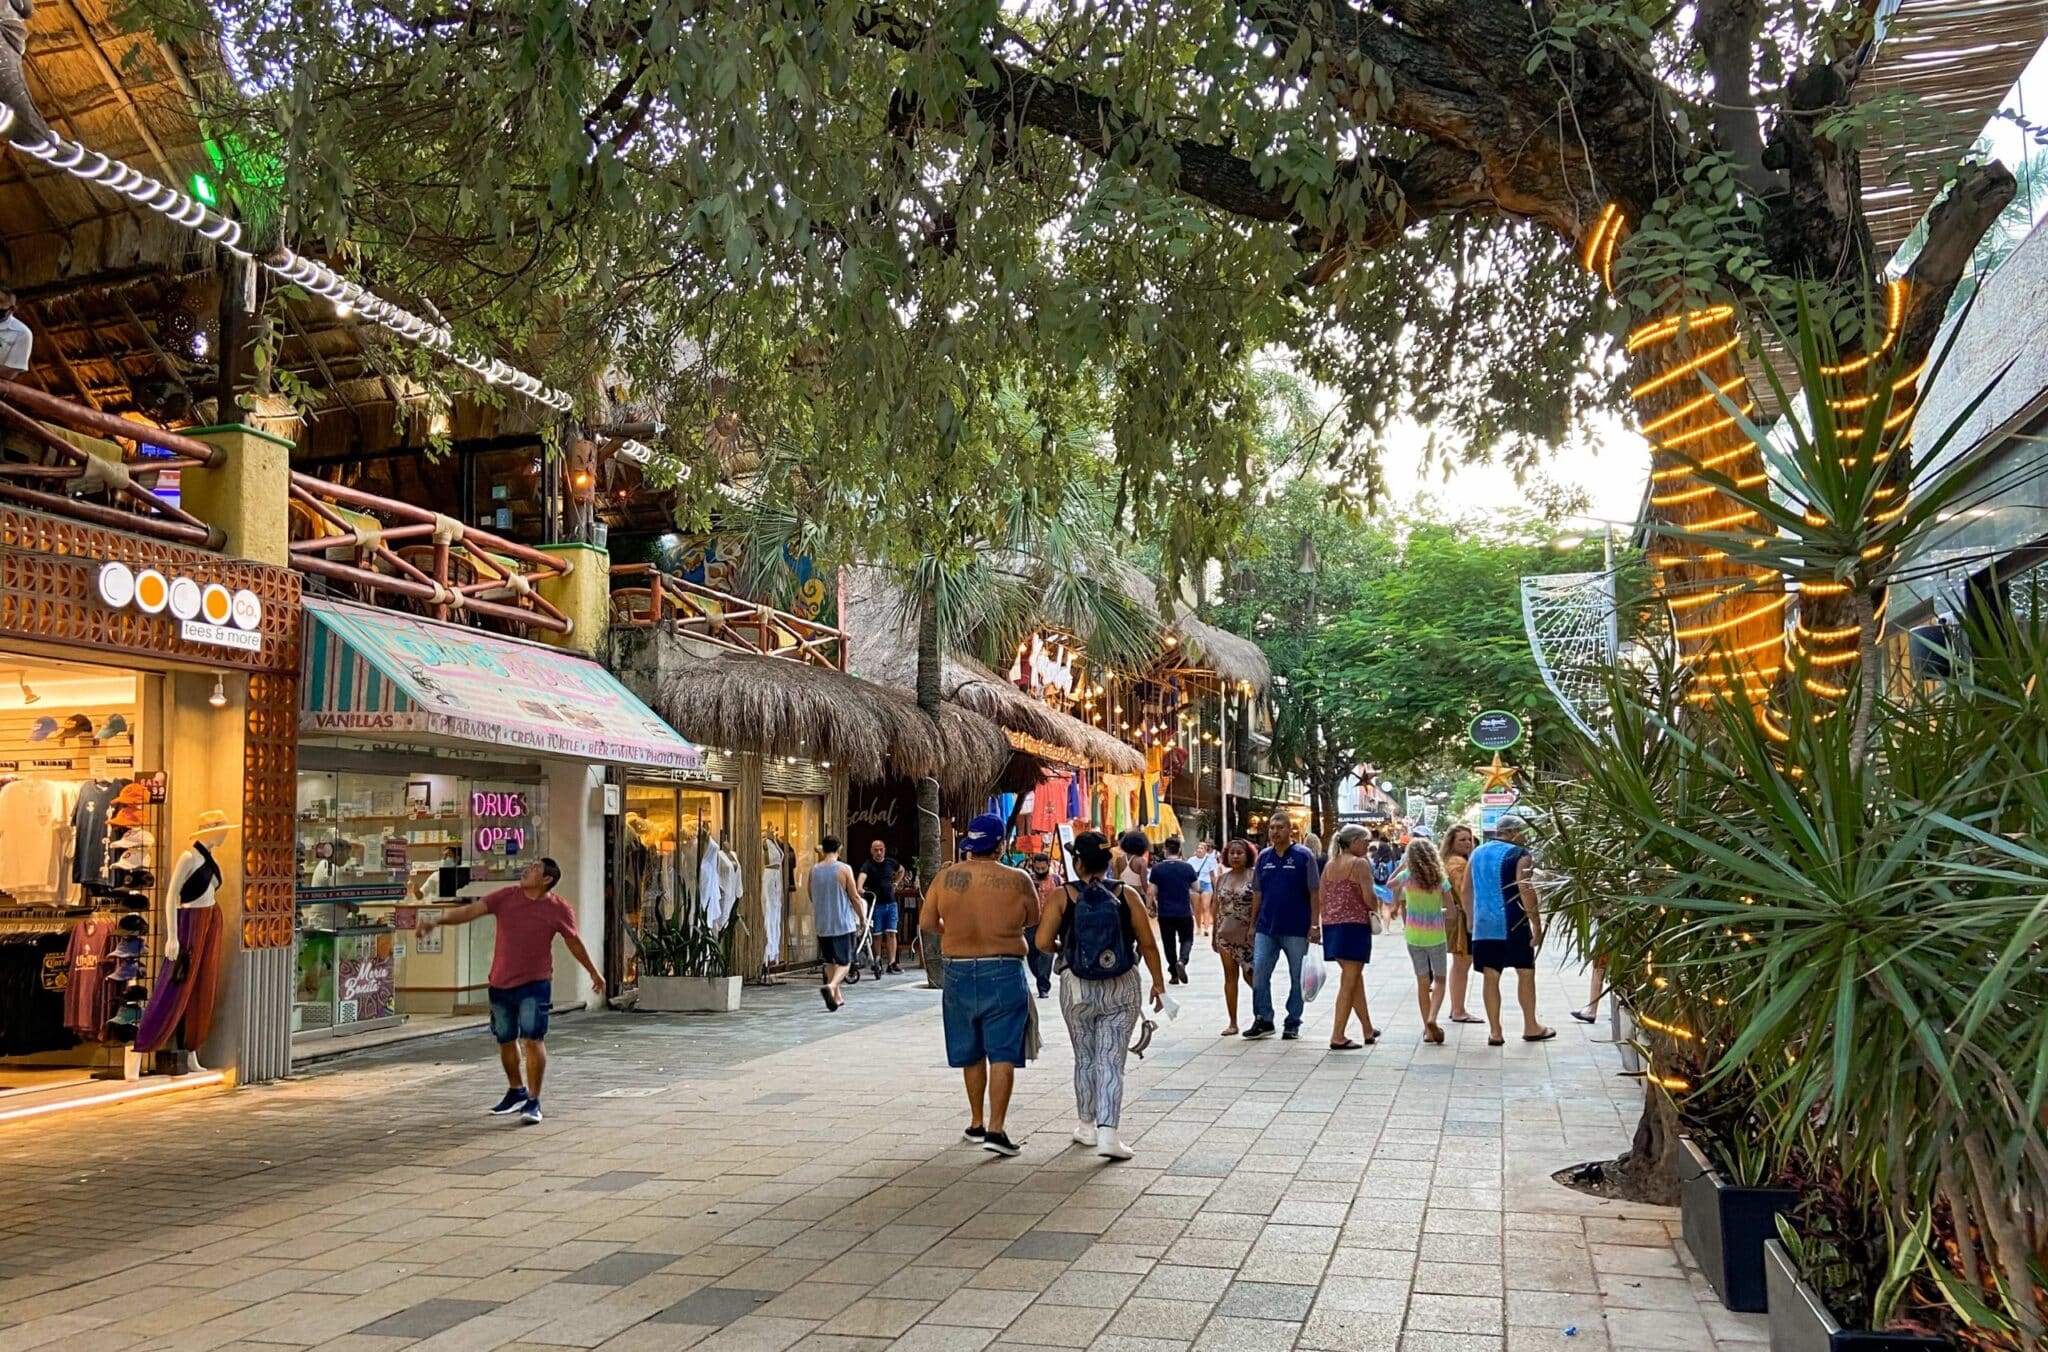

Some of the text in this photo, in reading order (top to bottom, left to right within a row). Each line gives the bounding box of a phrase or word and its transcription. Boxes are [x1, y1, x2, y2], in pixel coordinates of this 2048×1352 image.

[184, 623, 260, 647] tees & more
[316, 714, 394, 728] VANILLAS
[440, 716, 501, 740] PHARMACY
[511, 730, 545, 748] CREAM
[549, 734, 580, 752] TURTLE
[588, 740, 609, 756] BEER
[617, 744, 639, 760] WINE
[646, 750, 673, 765] PHOTO
[473, 792, 529, 817] DRUGS
[480, 827, 524, 851] OPEN
[356, 962, 388, 981] Maria
[344, 977, 379, 1000] Bonita
